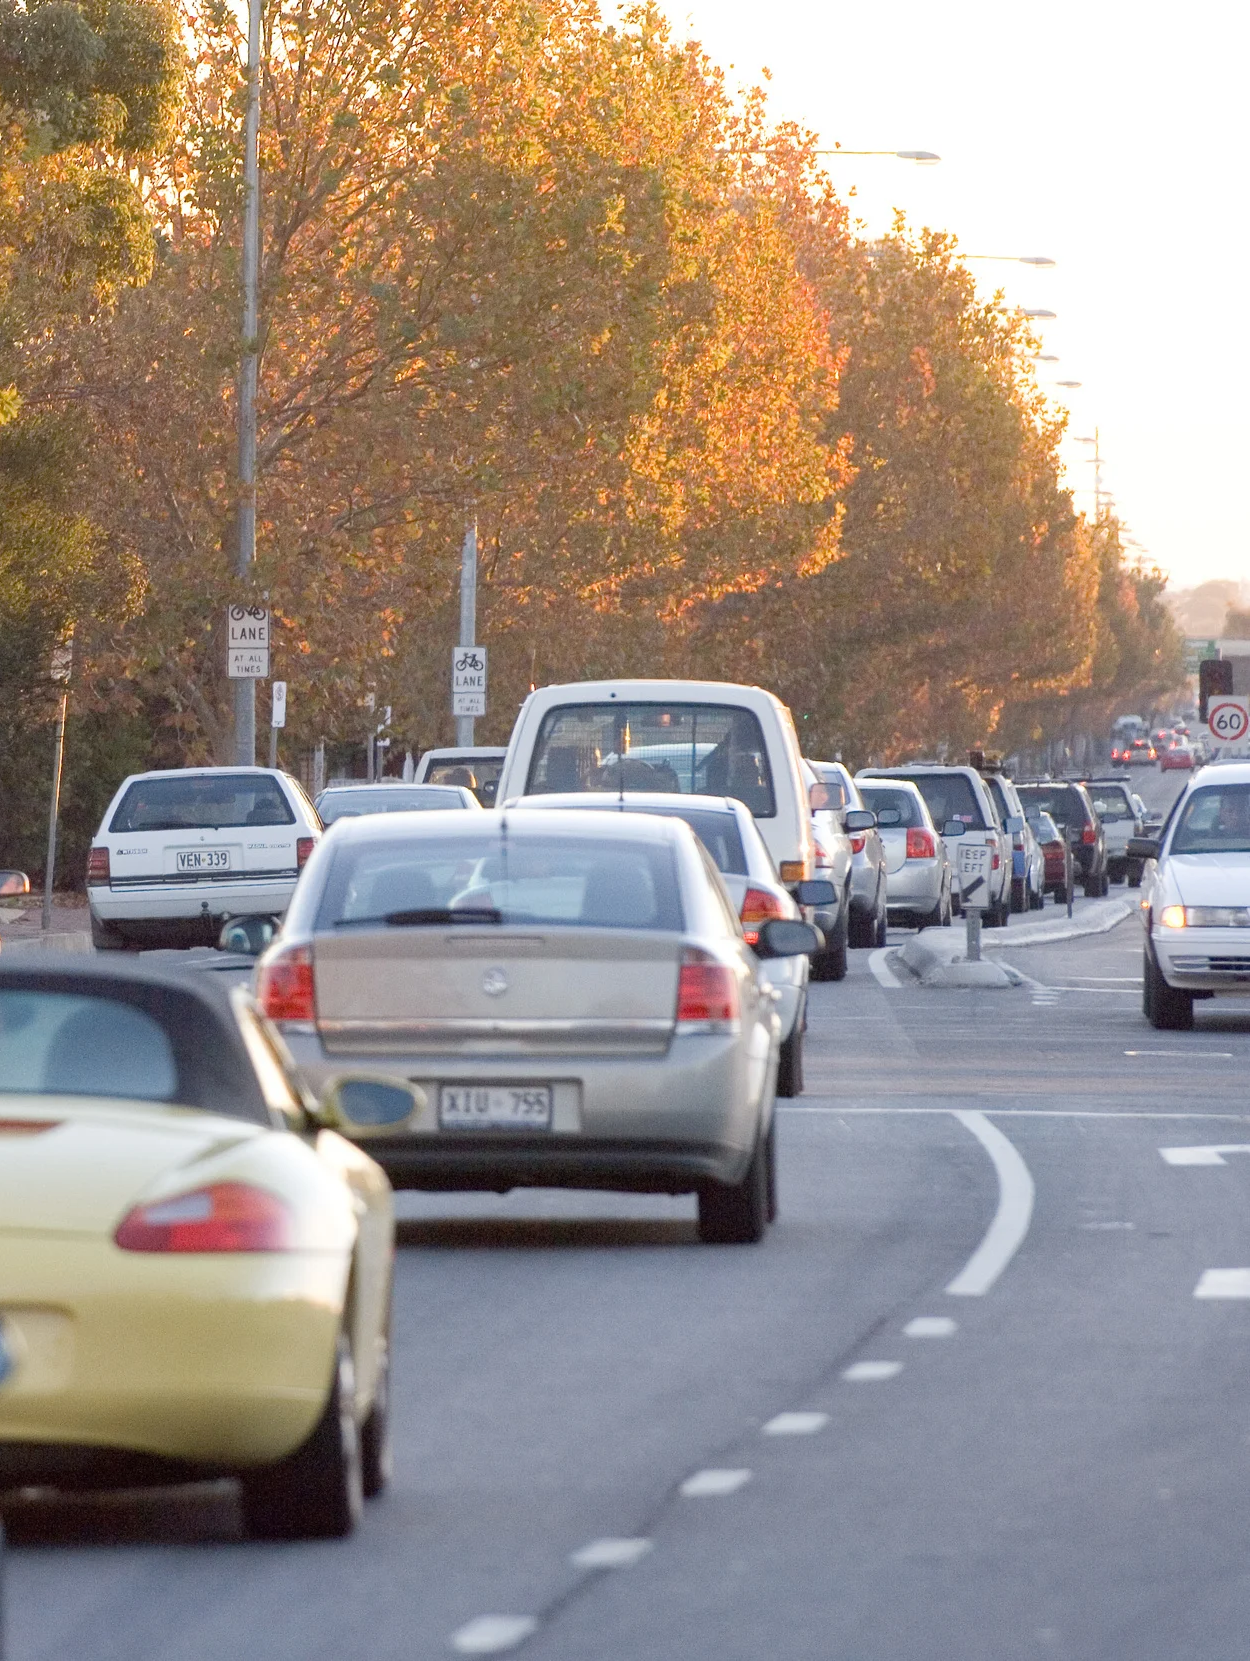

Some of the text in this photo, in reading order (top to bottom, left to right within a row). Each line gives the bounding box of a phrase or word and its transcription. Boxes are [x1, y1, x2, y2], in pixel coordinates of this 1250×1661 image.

[231, 627, 266, 640] LANE
[236, 665, 261, 673] TIMES
[455, 675, 483, 687] LANE
[1216, 713, 1241, 730] 60
[446, 1091, 546, 1114] XIU 755
